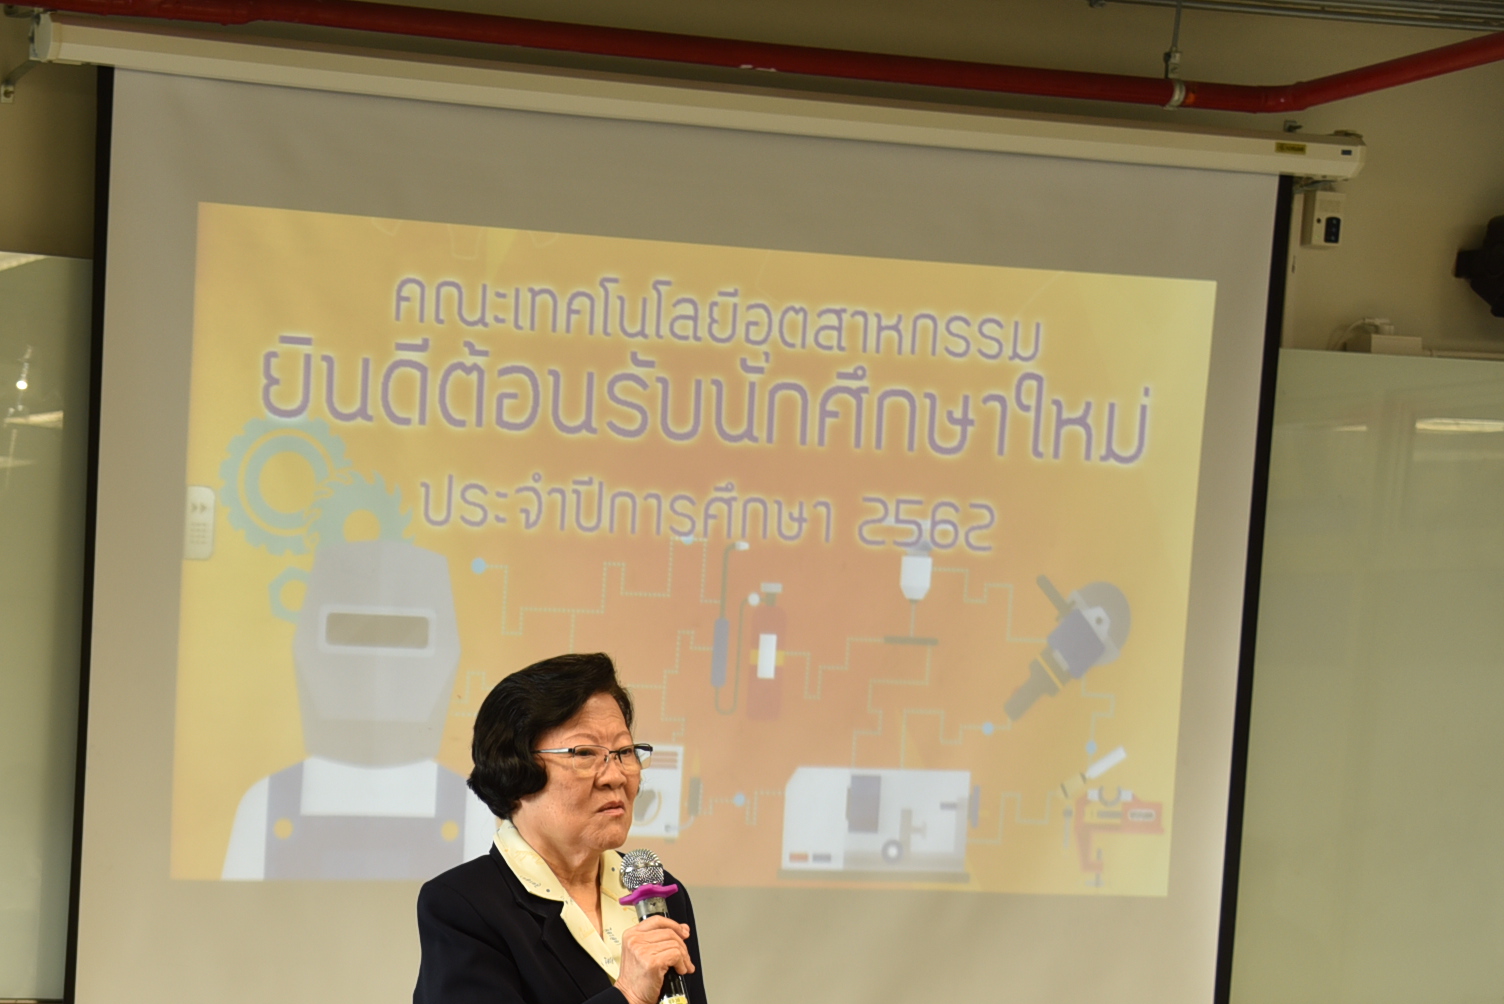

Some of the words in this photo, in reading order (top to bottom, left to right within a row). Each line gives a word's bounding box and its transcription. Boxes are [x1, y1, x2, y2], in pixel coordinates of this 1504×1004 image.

[395, 277, 1042, 364] คณะเทคโนโลยีอุตสาหกรรม
[262, 335, 1150, 464] ยินดีต้อนรับนักศึกษาใหม่
[420, 472, 832, 543] ประจำปีการศึกษา
[857, 496, 996, 552] 2562
